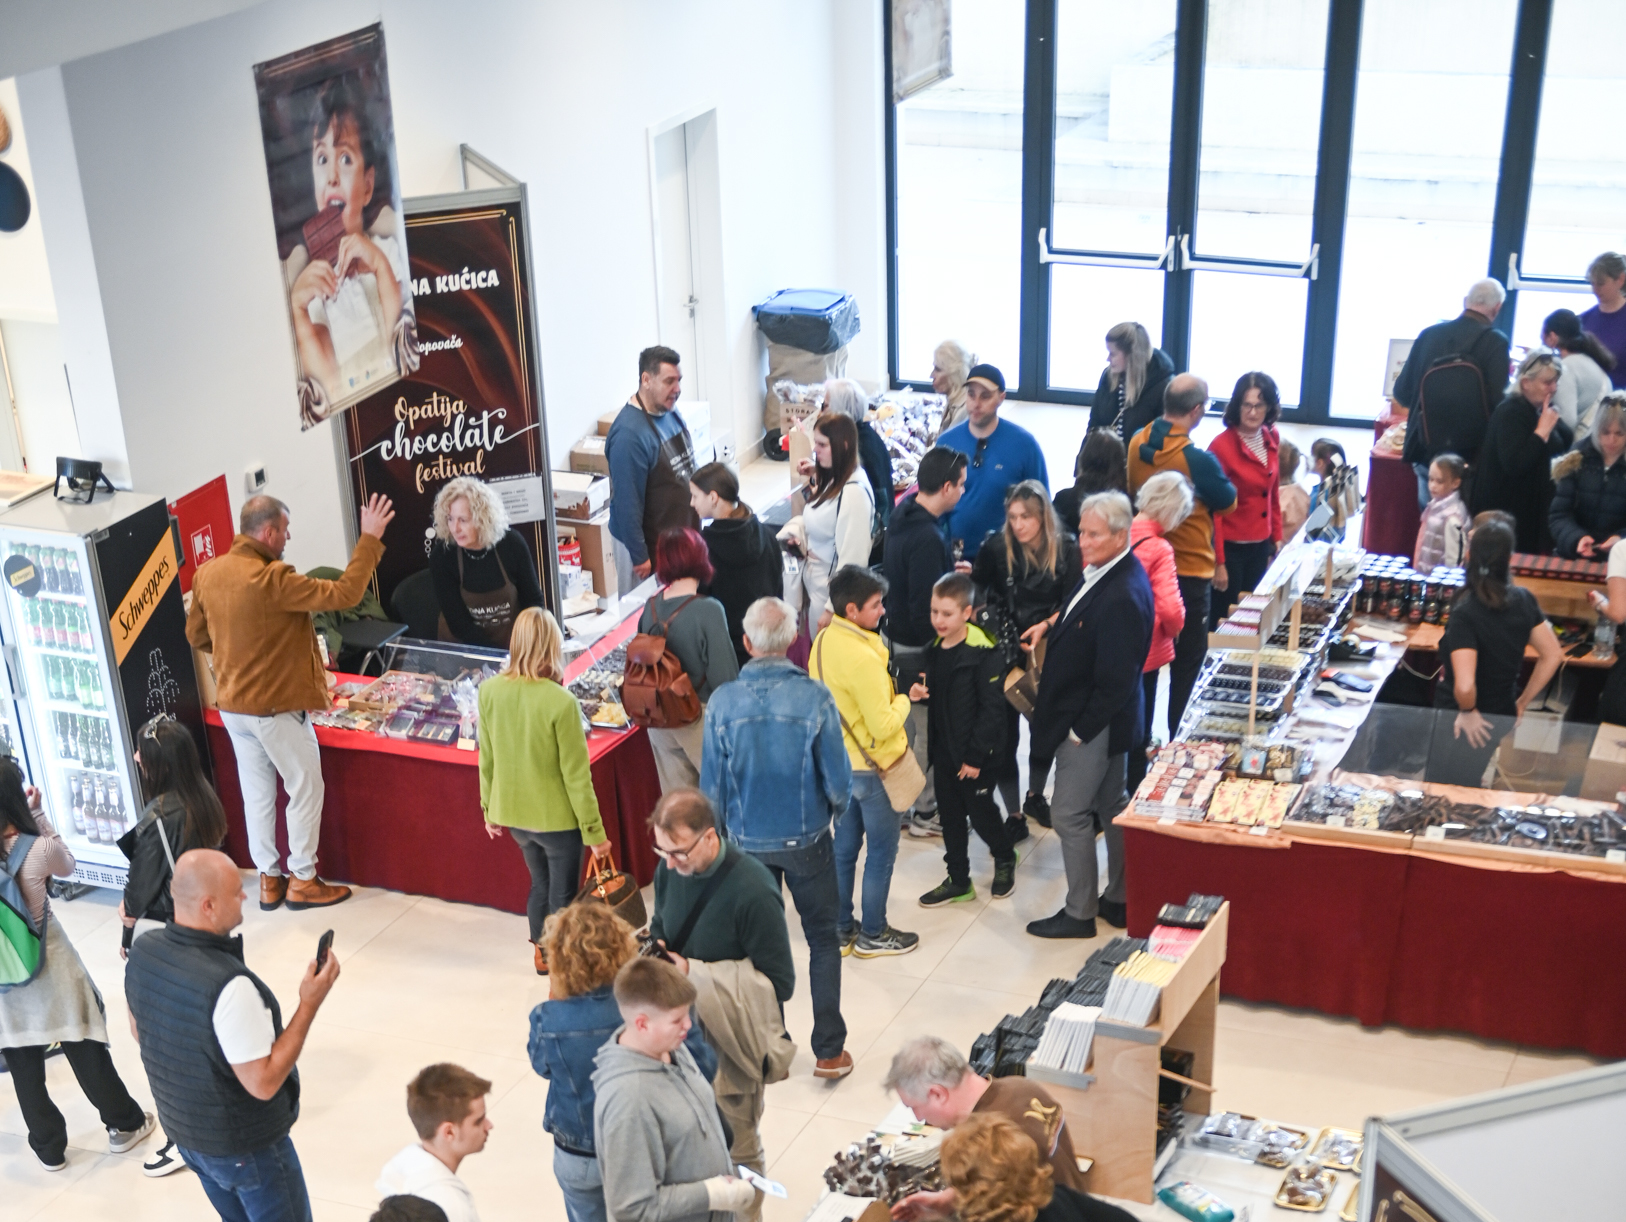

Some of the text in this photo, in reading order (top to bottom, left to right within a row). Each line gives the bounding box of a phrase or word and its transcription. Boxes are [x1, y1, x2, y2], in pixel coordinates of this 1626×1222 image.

[435, 266, 500, 293] KUĆICA
[417, 334, 463, 356] opovača
[394, 391, 467, 430] Opatija
[415, 449, 486, 494] festival
[118, 555, 170, 640] Schweppes
